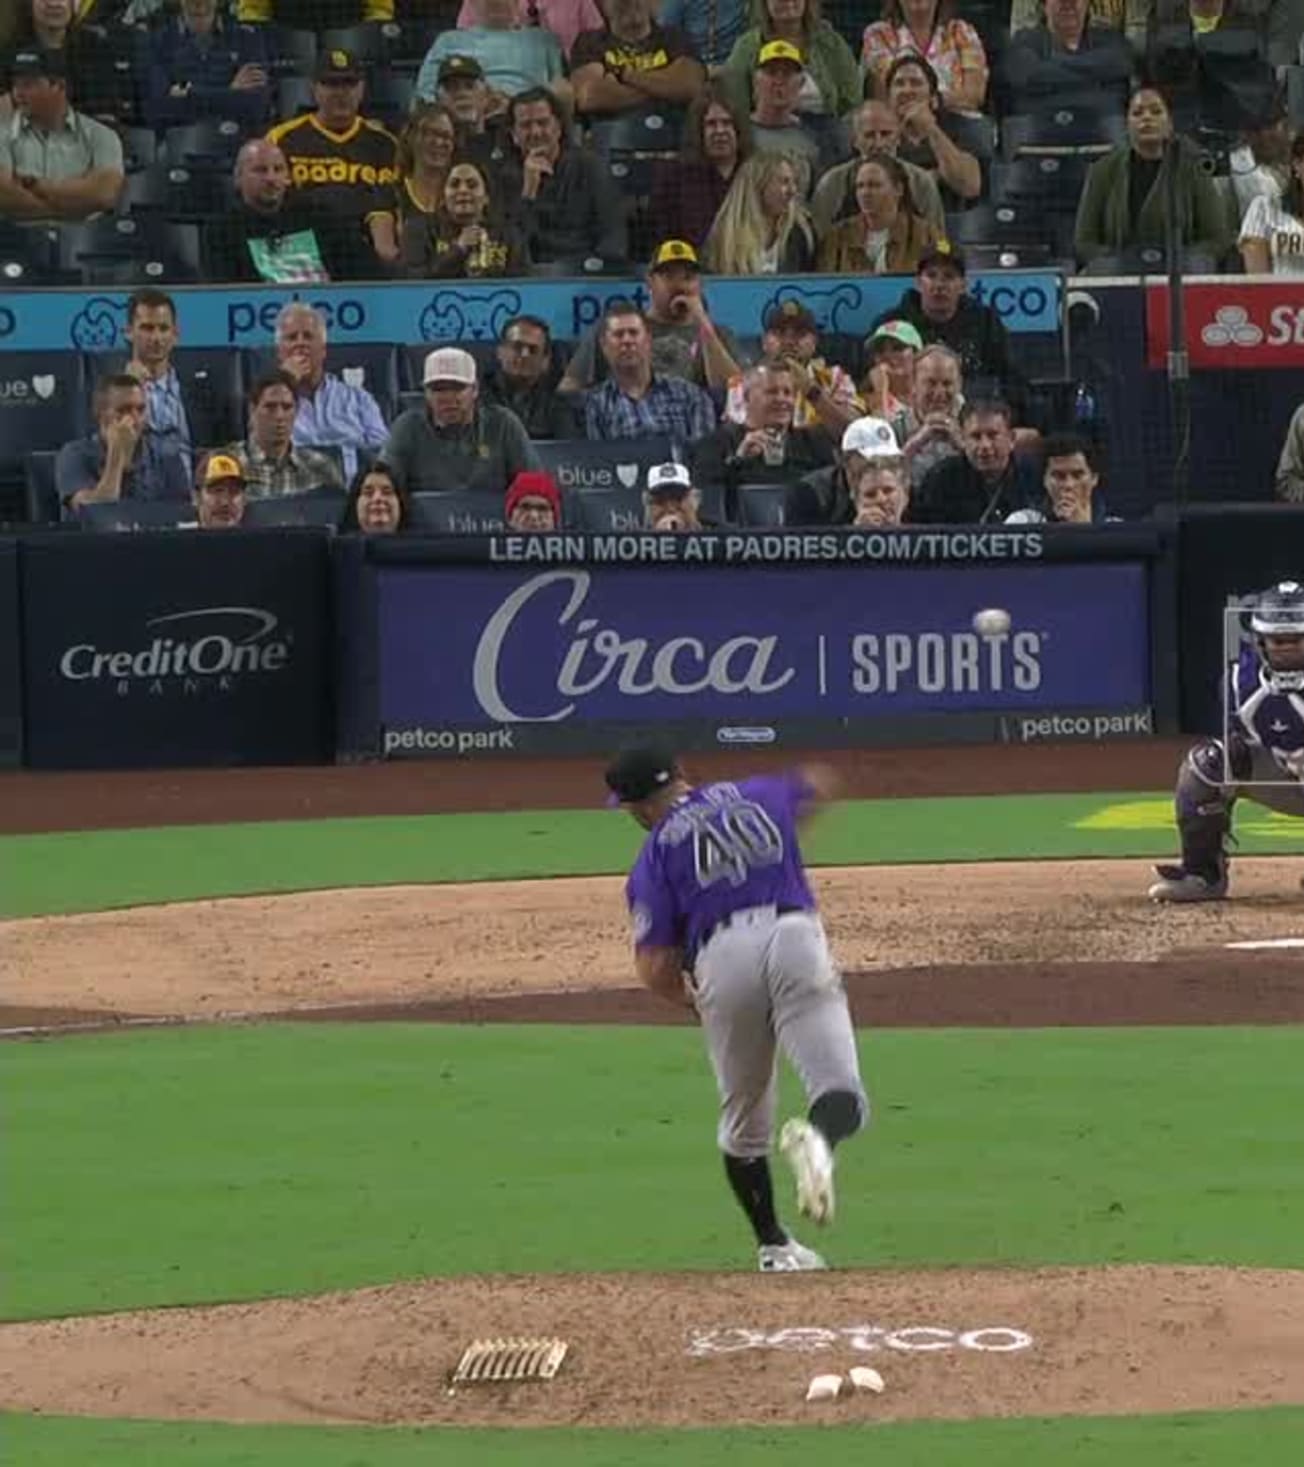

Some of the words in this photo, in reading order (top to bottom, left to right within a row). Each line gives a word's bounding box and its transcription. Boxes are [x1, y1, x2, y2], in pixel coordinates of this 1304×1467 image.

[227, 292, 365, 343] peco
[557, 464, 612, 487] blue
[489, 537, 584, 561] LEARN
[593, 536, 676, 560] MORE
[683, 535, 718, 560] AT
[726, 533, 1043, 560] PADRES.COM/TICKETS
[473, 570, 795, 722] Circa
[852, 631, 1041, 693] SPORTS
[117, 676, 231, 695] BANK
[384, 729, 456, 754] petco
[458, 726, 514, 754] park
[1021, 717, 1091, 742] petco
[1094, 711, 1148, 739] park
[693, 799, 784, 889] 40
[685, 1323, 1034, 1356] petco
